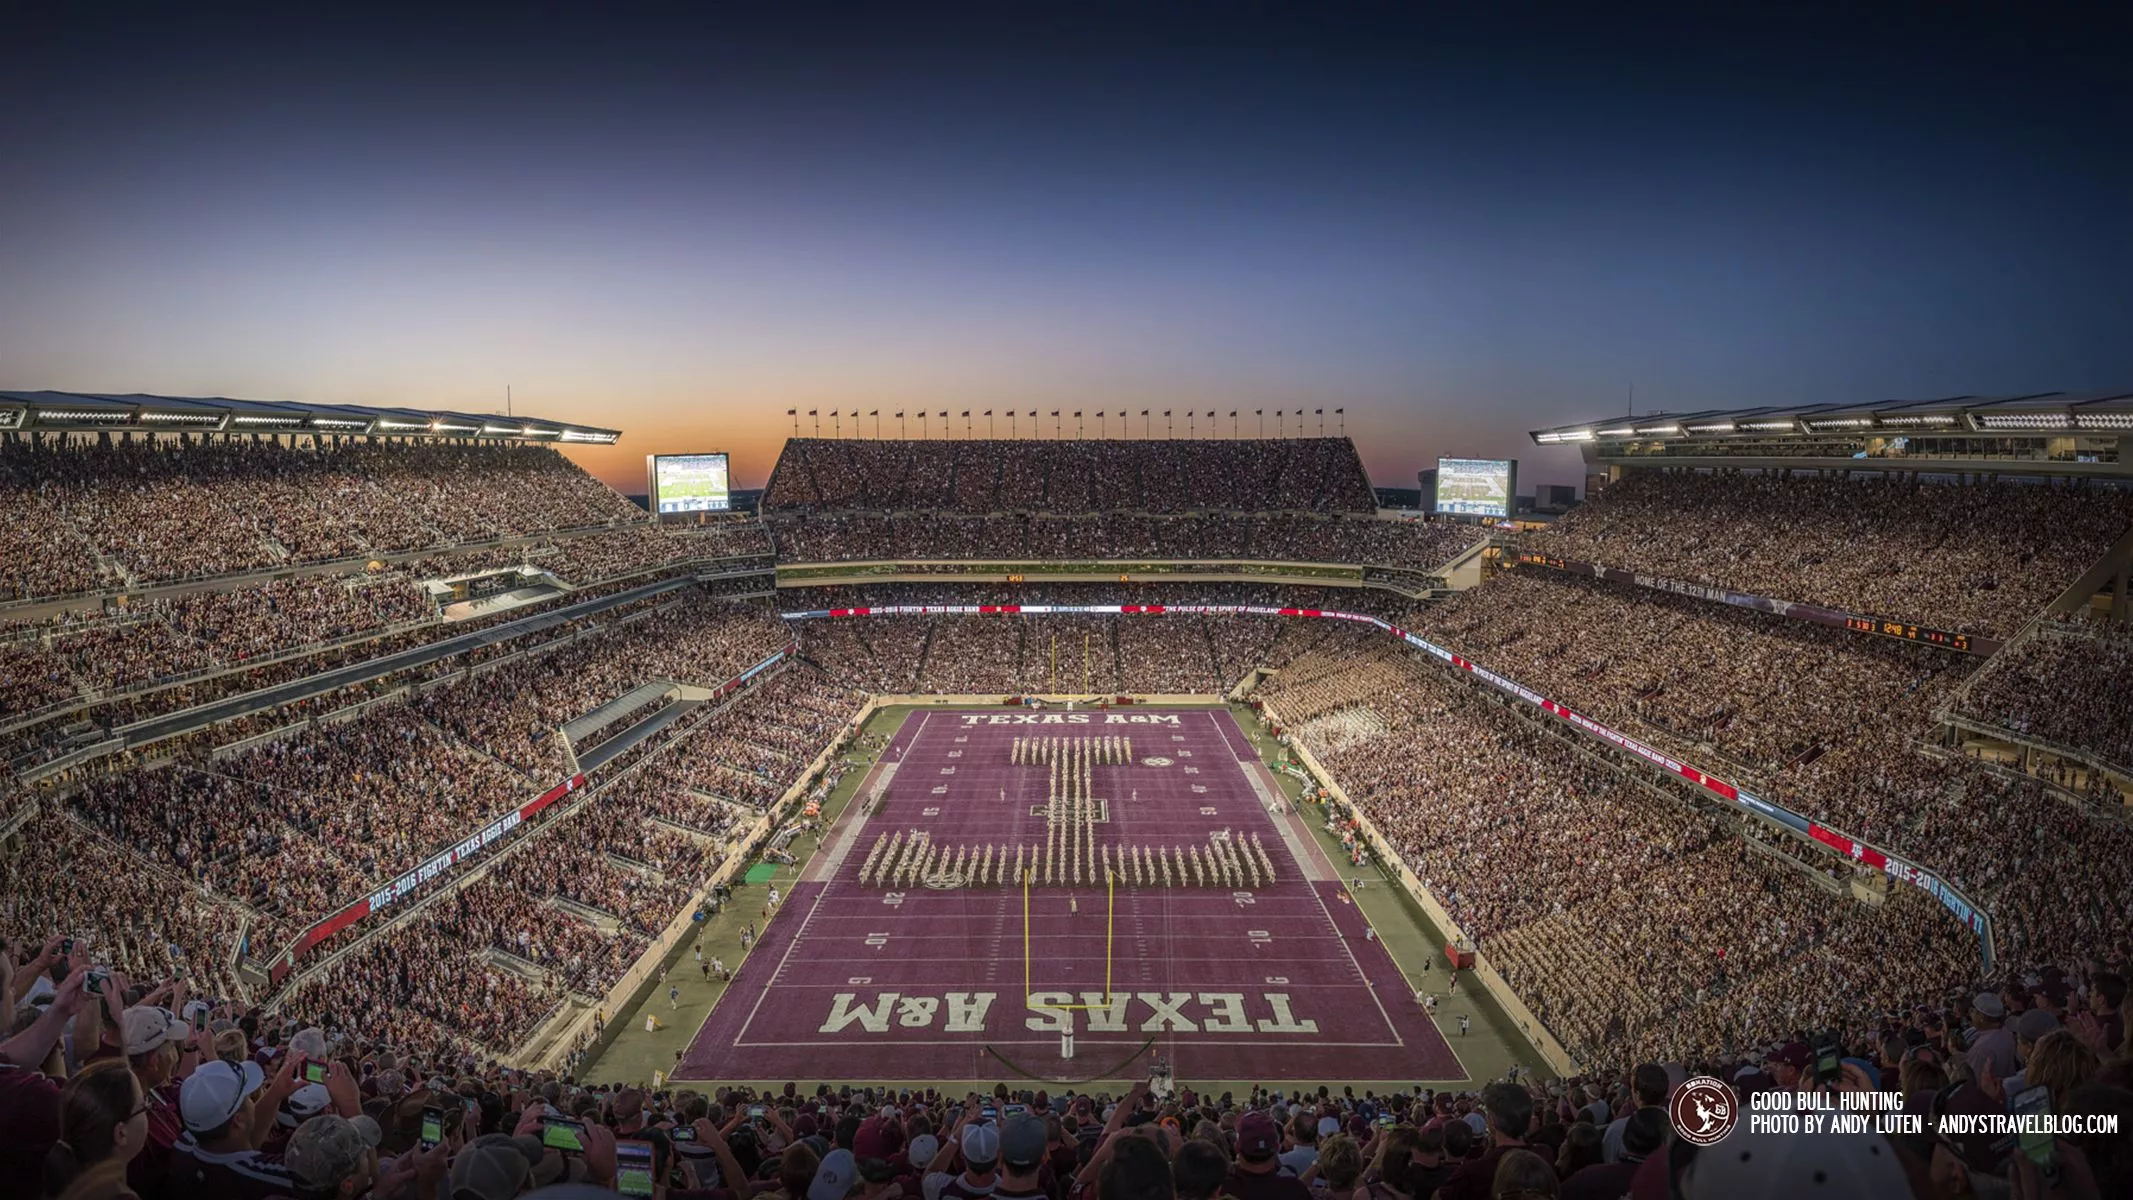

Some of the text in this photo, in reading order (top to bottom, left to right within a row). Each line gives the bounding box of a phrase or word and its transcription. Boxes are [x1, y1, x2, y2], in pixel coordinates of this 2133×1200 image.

[1634, 574, 1655, 588] HOME
[1657, 578, 1668, 590] OF
[1670, 581, 1686, 593] THE
[1706, 587, 1726, 603] MAN
[961, 714, 1182, 725] TEXAS A&M
[369, 874, 417, 912] 2015-2016
[455, 837, 481, 860] TEXAS
[481, 824, 502, 845] AGGIE
[503, 811, 521, 832] BAND
[1884, 857, 1940, 897] 2015-2016
[818, 991, 1320, 1033] TEXAS A&M
